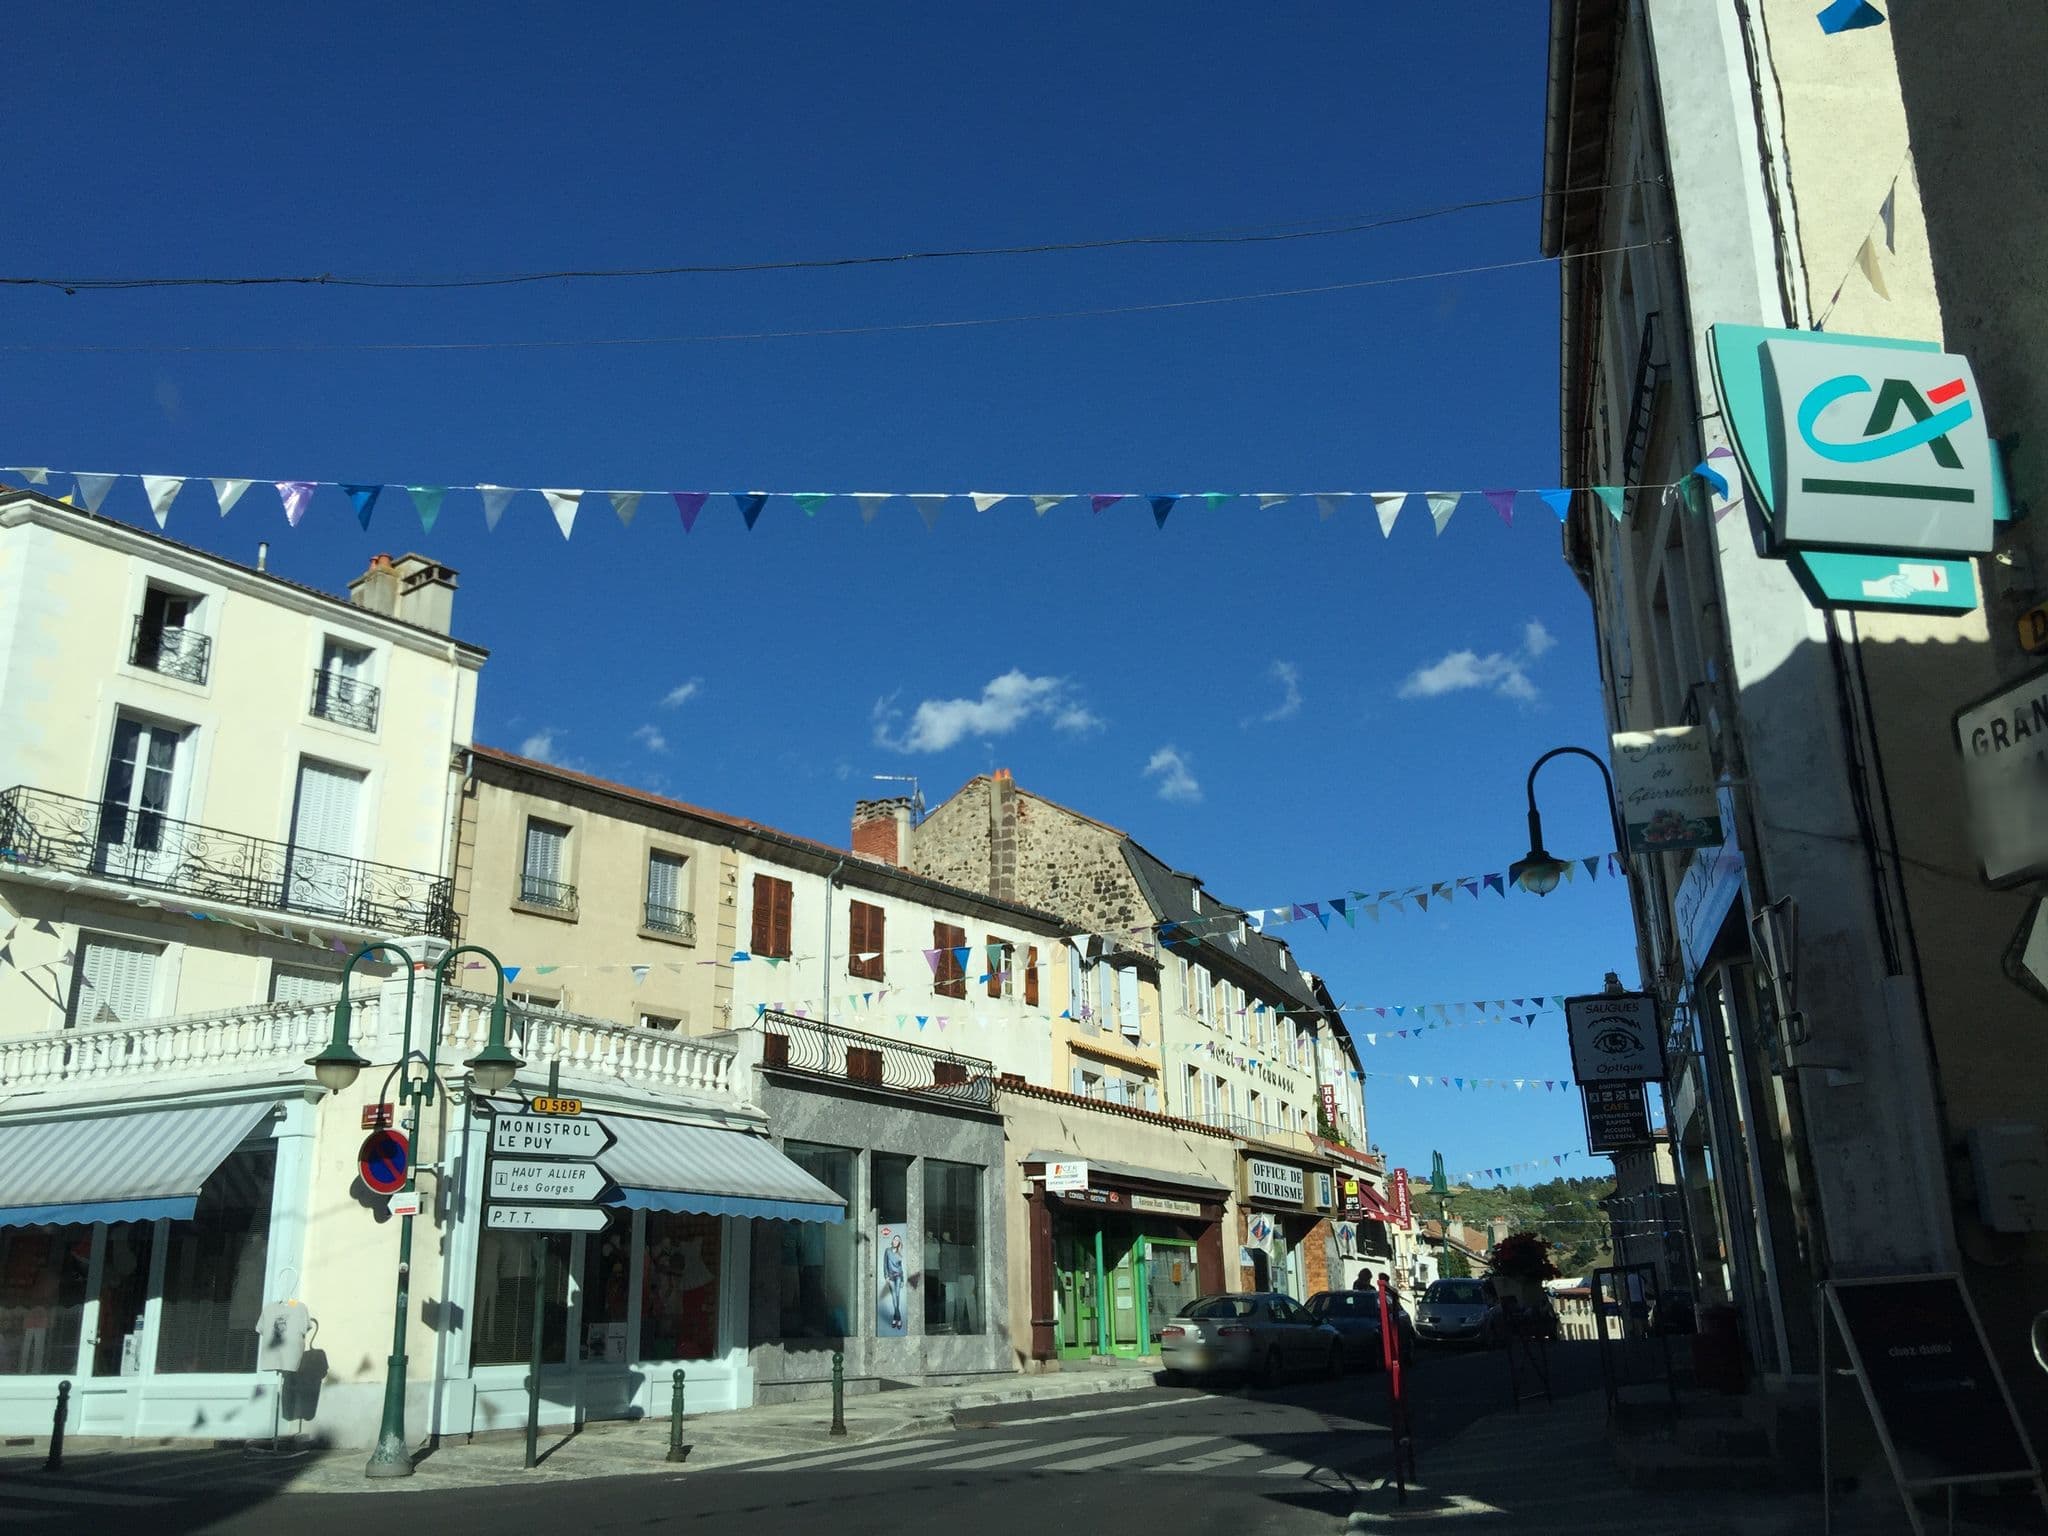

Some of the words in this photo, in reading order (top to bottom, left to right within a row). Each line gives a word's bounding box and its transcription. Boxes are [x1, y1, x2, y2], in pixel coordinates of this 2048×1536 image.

[1585, 1003, 1640, 1014] SAUGUES
[540, 1099, 548, 1111] D
[552, 1100, 577, 1112] 589
[500, 1119, 591, 1137] MONISTROL
[499, 1135, 516, 1147] LE
[524, 1136, 553, 1149] PUY
[511, 1167, 543, 1178] HAUT
[547, 1168, 587, 1180] ALLIER
[1253, 1162, 1288, 1182] OFFICE
[1290, 1170, 1303, 1185] DE
[510, 1182, 529, 1192] Les
[535, 1182, 575, 1195] Gorges
[1254, 1180, 1304, 1201] TOURISME
[492, 1210, 535, 1224] P.T.T.
